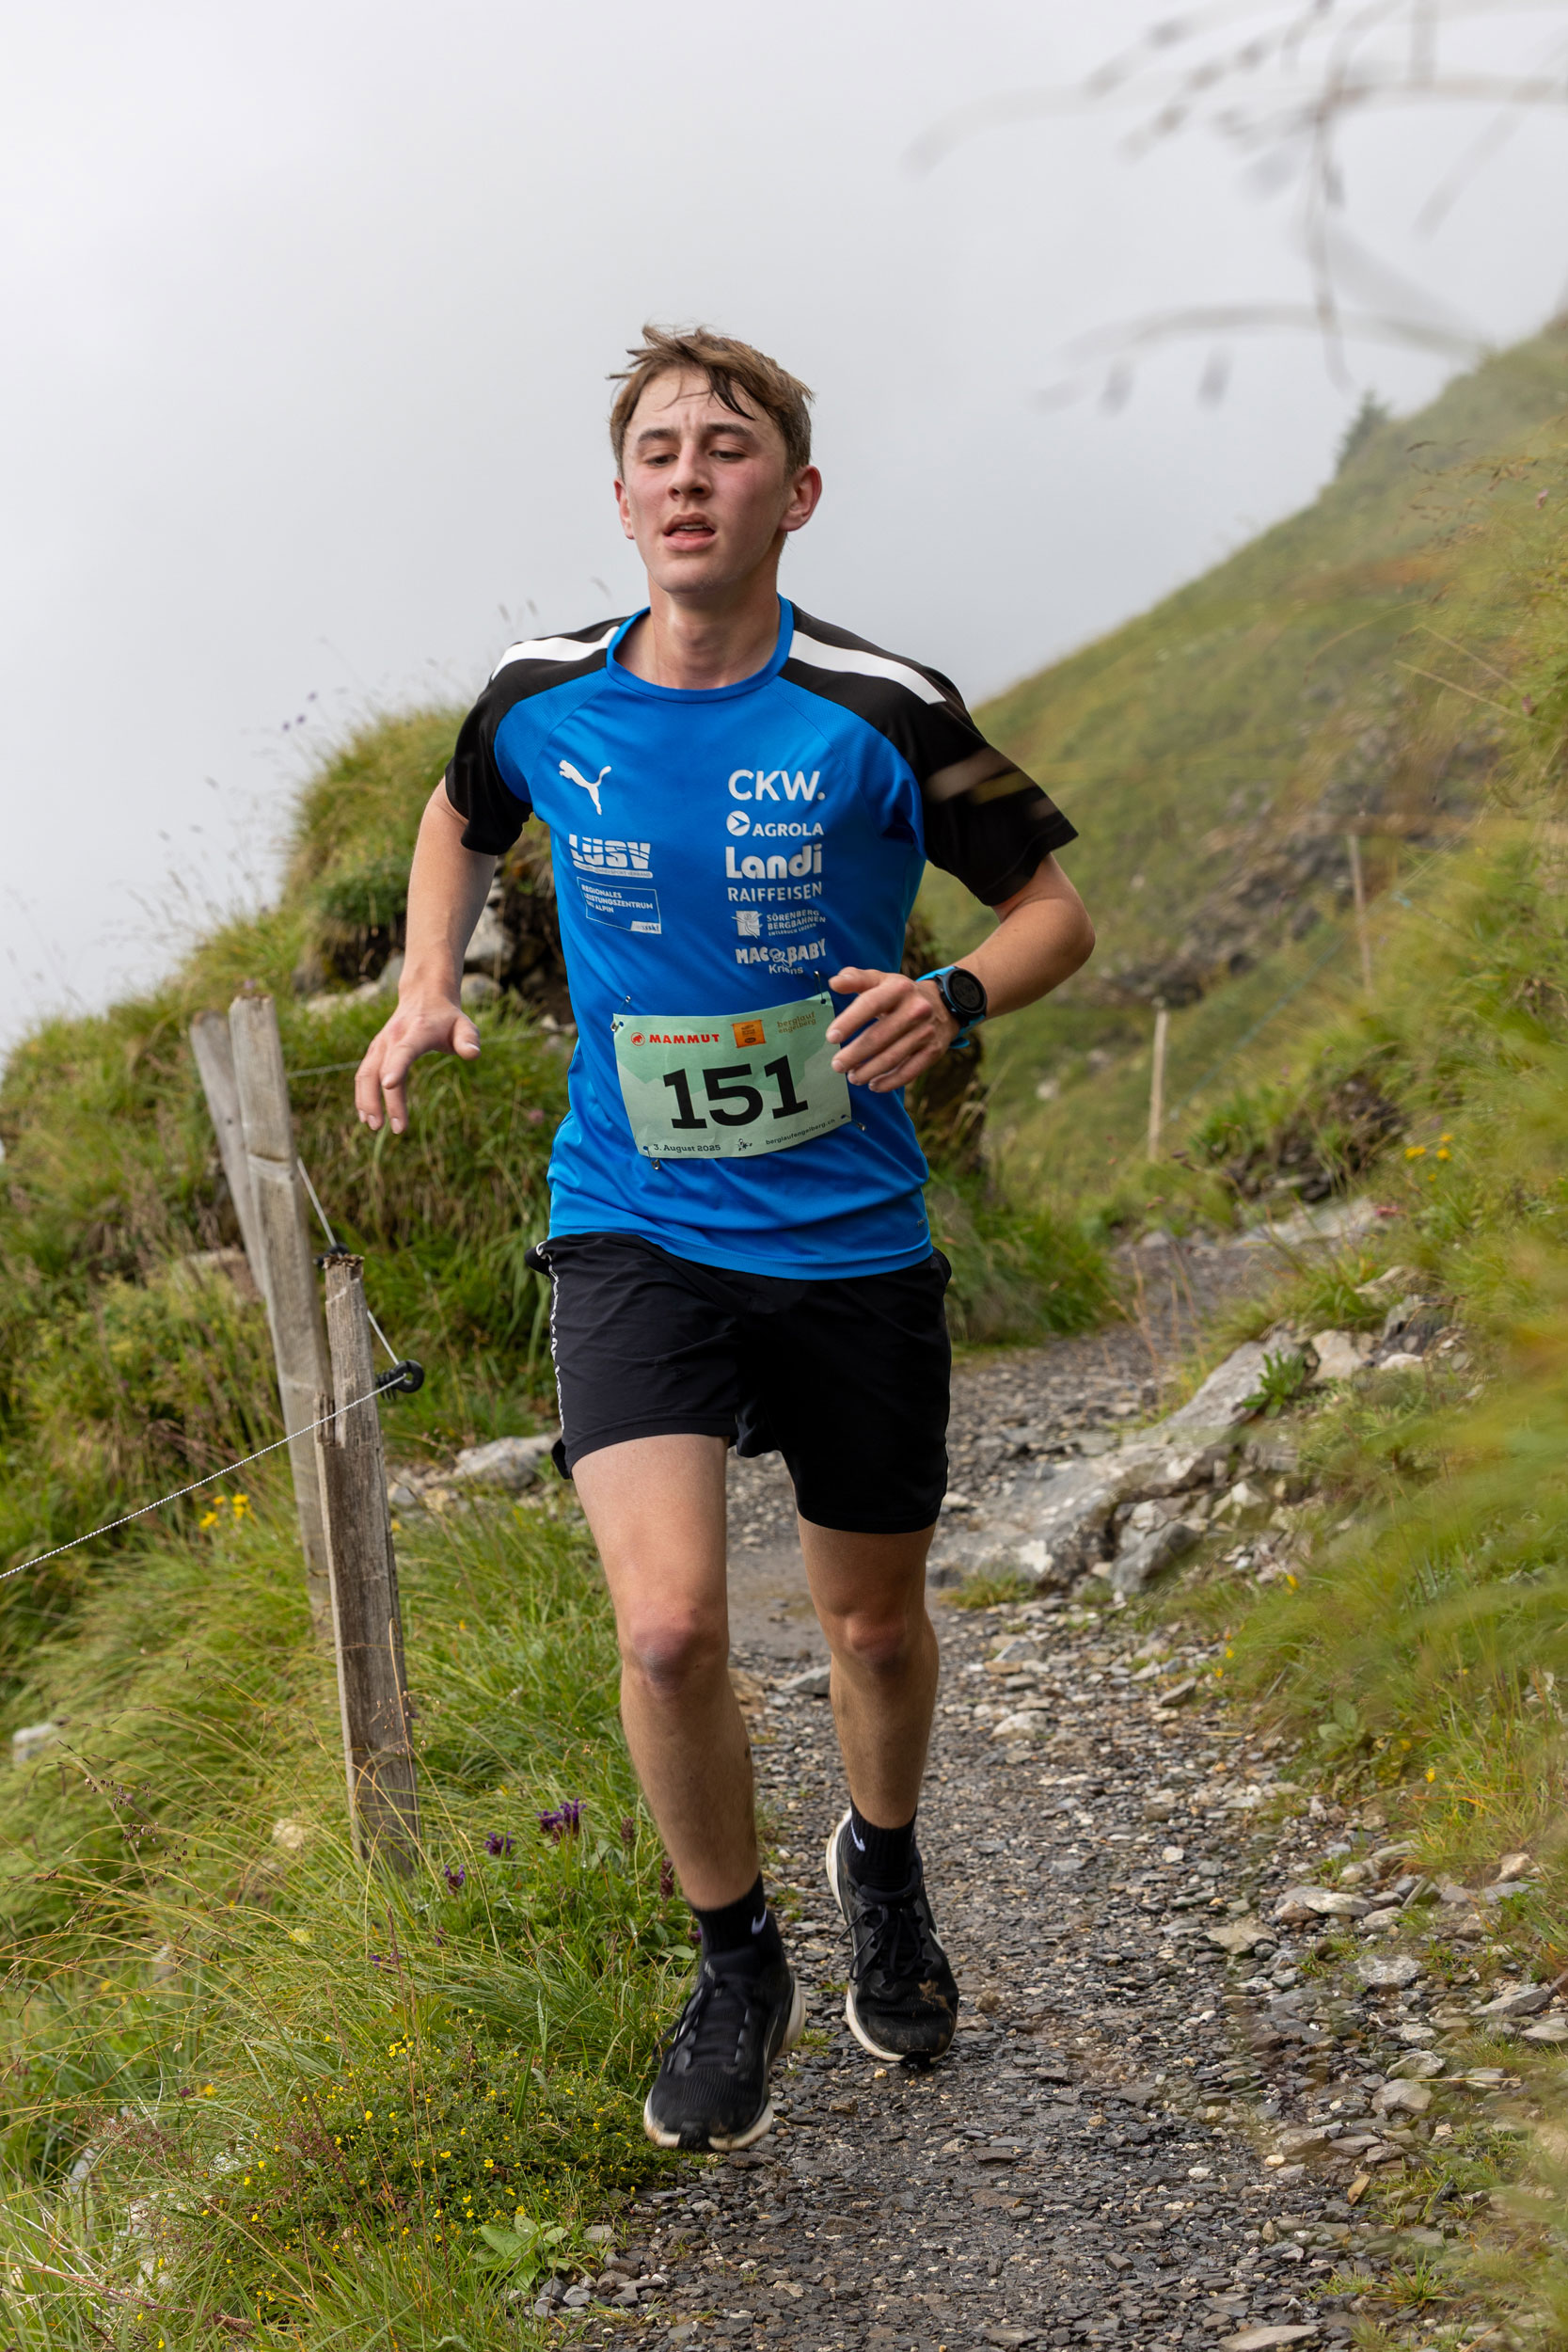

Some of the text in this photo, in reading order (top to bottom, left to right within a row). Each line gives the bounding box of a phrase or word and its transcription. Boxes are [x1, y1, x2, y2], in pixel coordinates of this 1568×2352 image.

[728, 769, 826, 802] CKW.
[752, 822, 824, 837] AGROLA
[725, 843, 822, 880] Landi
[581, 884, 622, 898] REGIONALES
[727, 881, 823, 902] RAIFFEISEN
[584, 893, 653, 909] LEISTUNGSZENTRUM
[594, 903, 614, 913] ALPIN
[767, 910, 819, 922] SÖRENBERG
[768, 916, 826, 930] BERGBAHNEN
[776, 1010, 816, 1027] berglauf
[778, 1017, 817, 1034] engelberg
[649, 1033, 720, 1043] MAMMUT
[662, 1055, 809, 1129] 151
[765, 1119, 836, 1145] berglaufengelberg.ch
[663, 1144, 695, 1153] August
